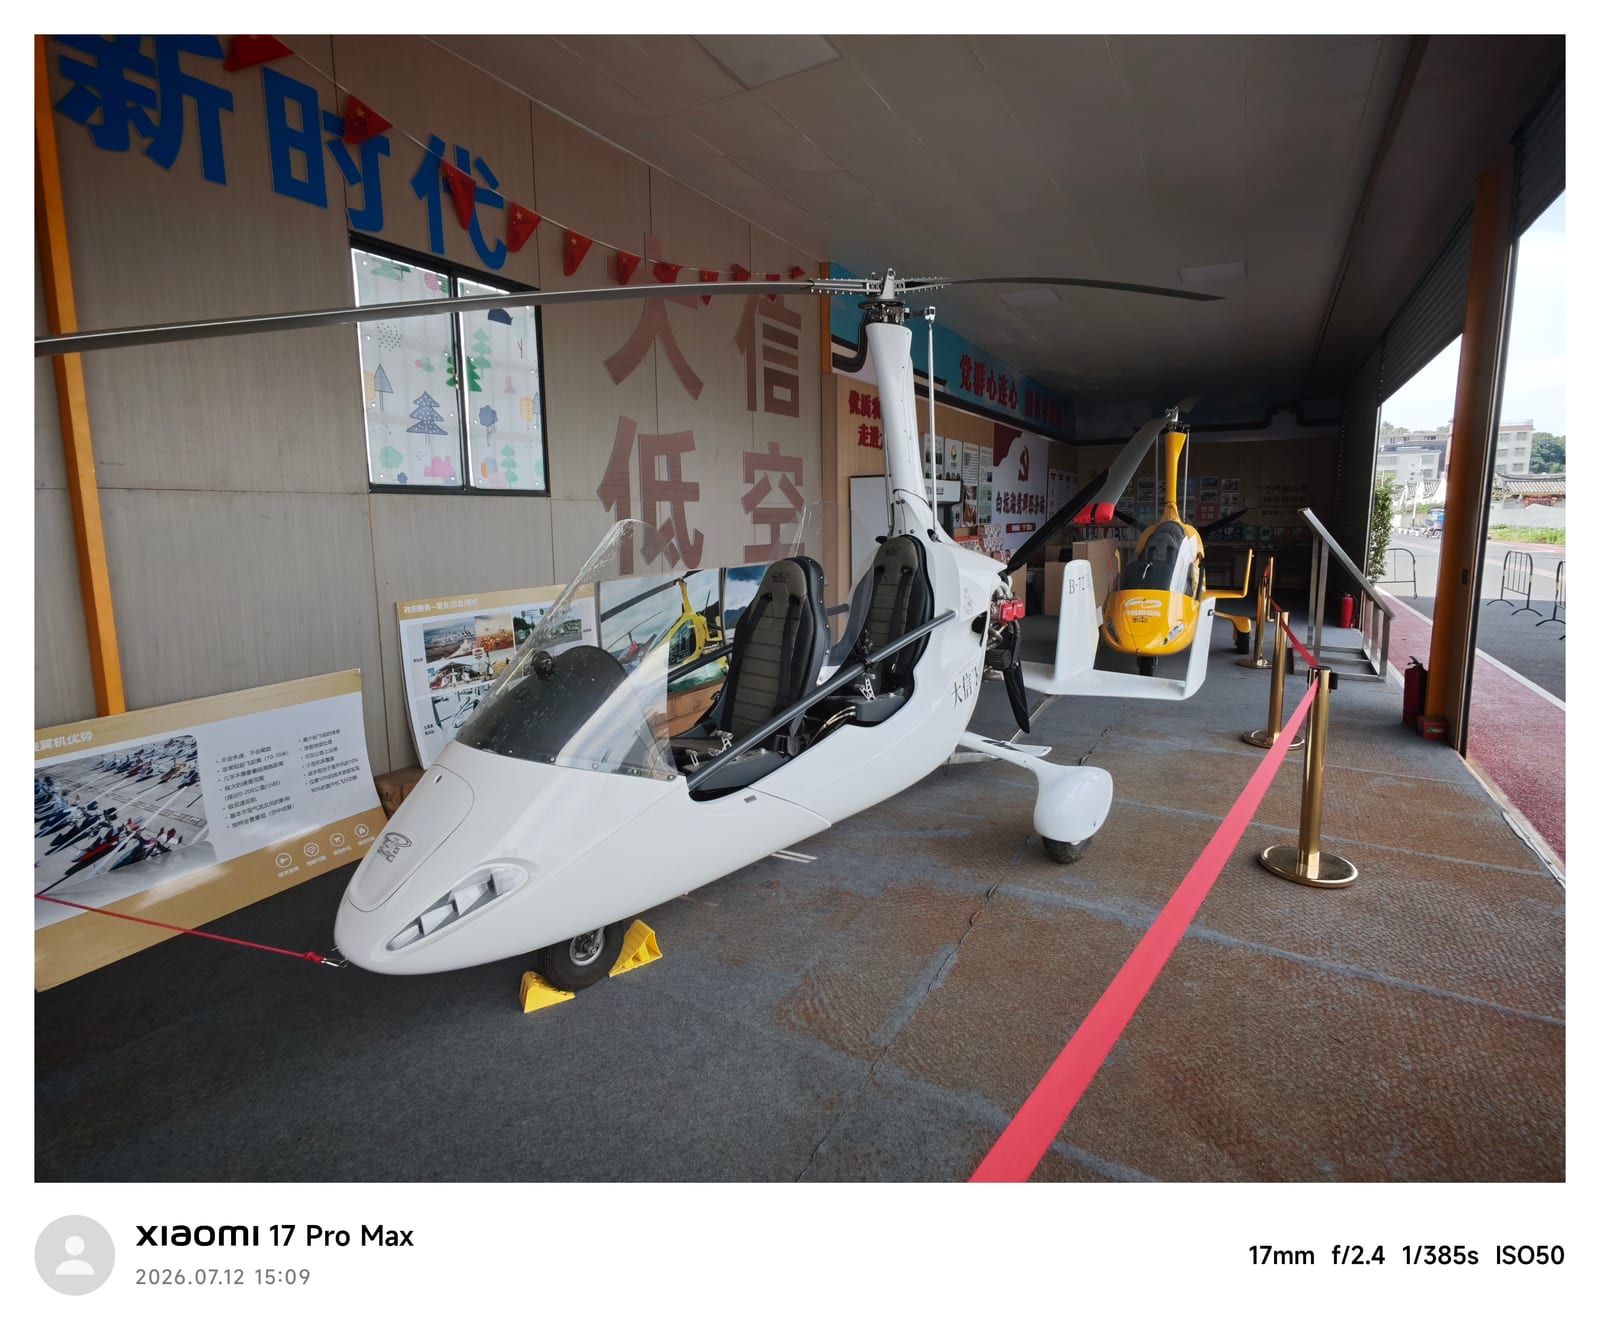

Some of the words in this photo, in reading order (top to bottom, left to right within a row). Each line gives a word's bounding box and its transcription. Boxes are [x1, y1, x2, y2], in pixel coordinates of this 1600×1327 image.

[53, 35, 508, 270] 新时代
[603, 237, 805, 418] 大信
[959, 353, 1018, 411] 党群心连心
[596, 415, 805, 575] 低空
